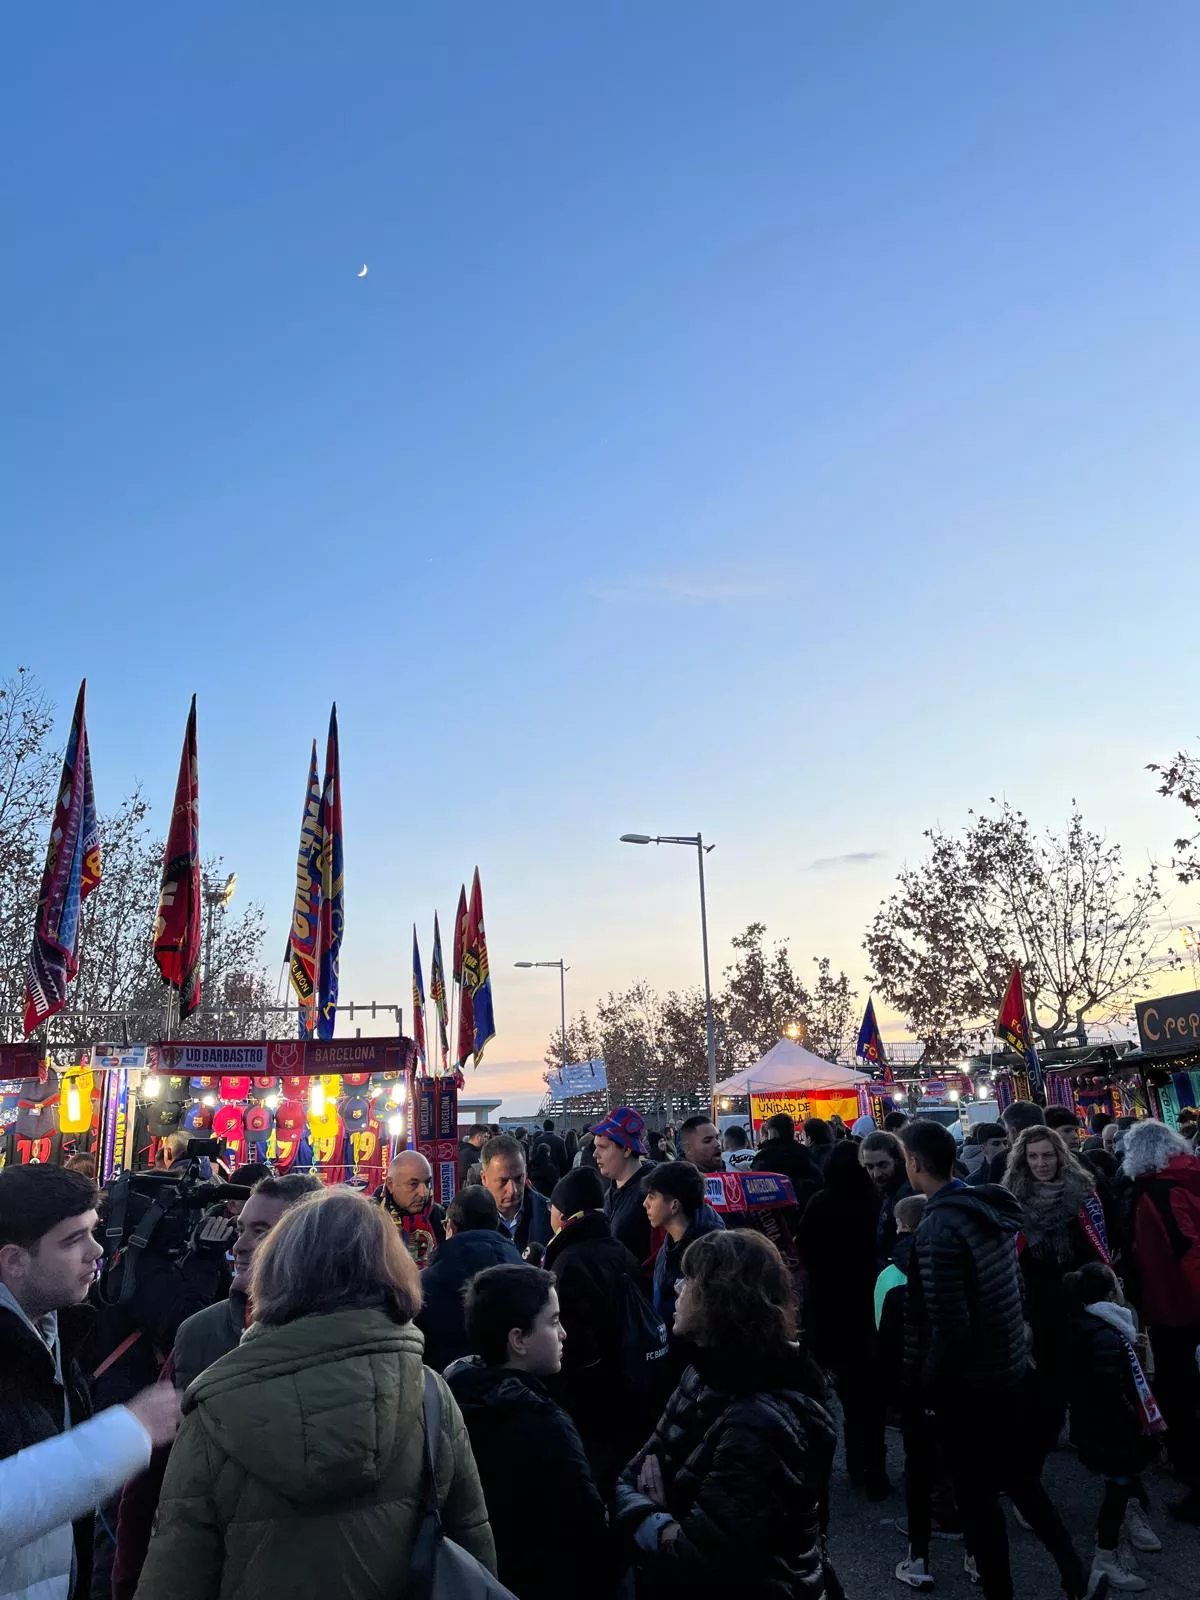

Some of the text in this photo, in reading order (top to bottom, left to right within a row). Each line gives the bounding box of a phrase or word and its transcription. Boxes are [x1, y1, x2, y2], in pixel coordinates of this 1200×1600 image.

[186, 1048, 263, 1063] UD BARBASTRO
[315, 1047, 375, 1062] BARCELONA
[441, 1095, 450, 1134] BARCELONA
[797, 1102, 811, 1112] DE
[421, 1097, 429, 1135] BARCELONA
